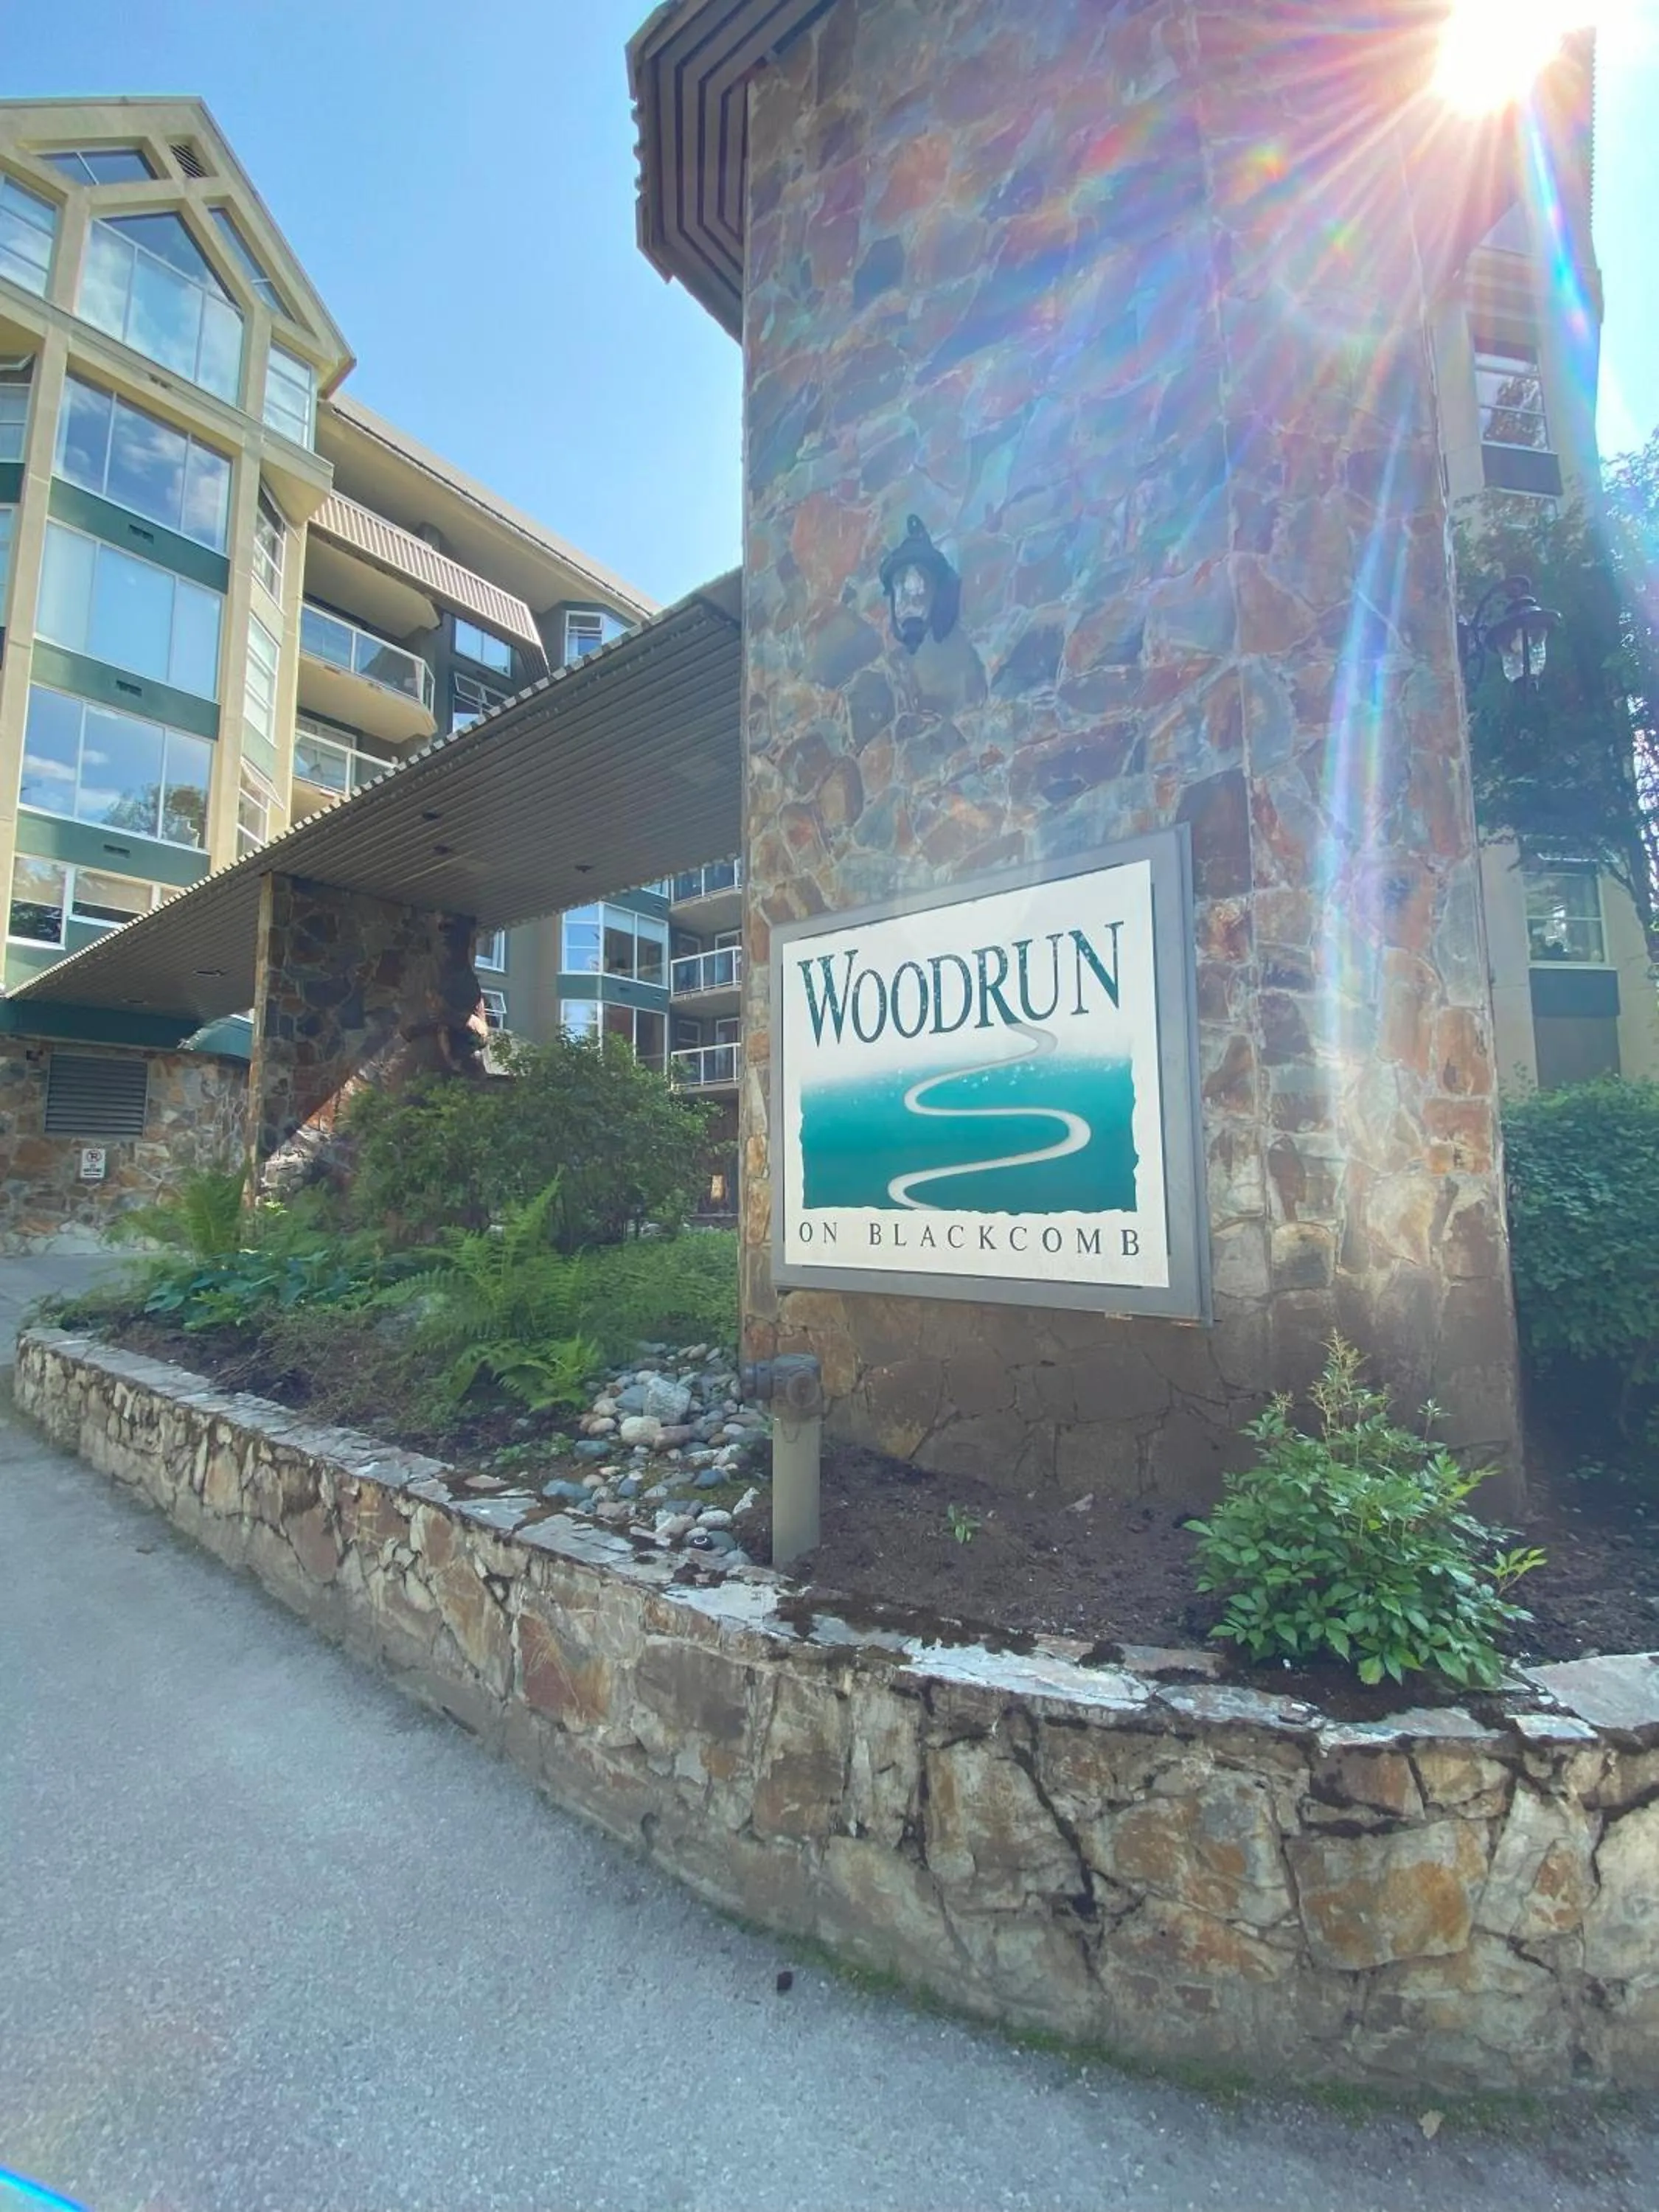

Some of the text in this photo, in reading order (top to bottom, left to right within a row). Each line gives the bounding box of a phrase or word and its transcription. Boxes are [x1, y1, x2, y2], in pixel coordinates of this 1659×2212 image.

[797, 921, 1124, 1047] WOODRUN
[799, 1221, 1140, 1256] ON BLACKCOMB
